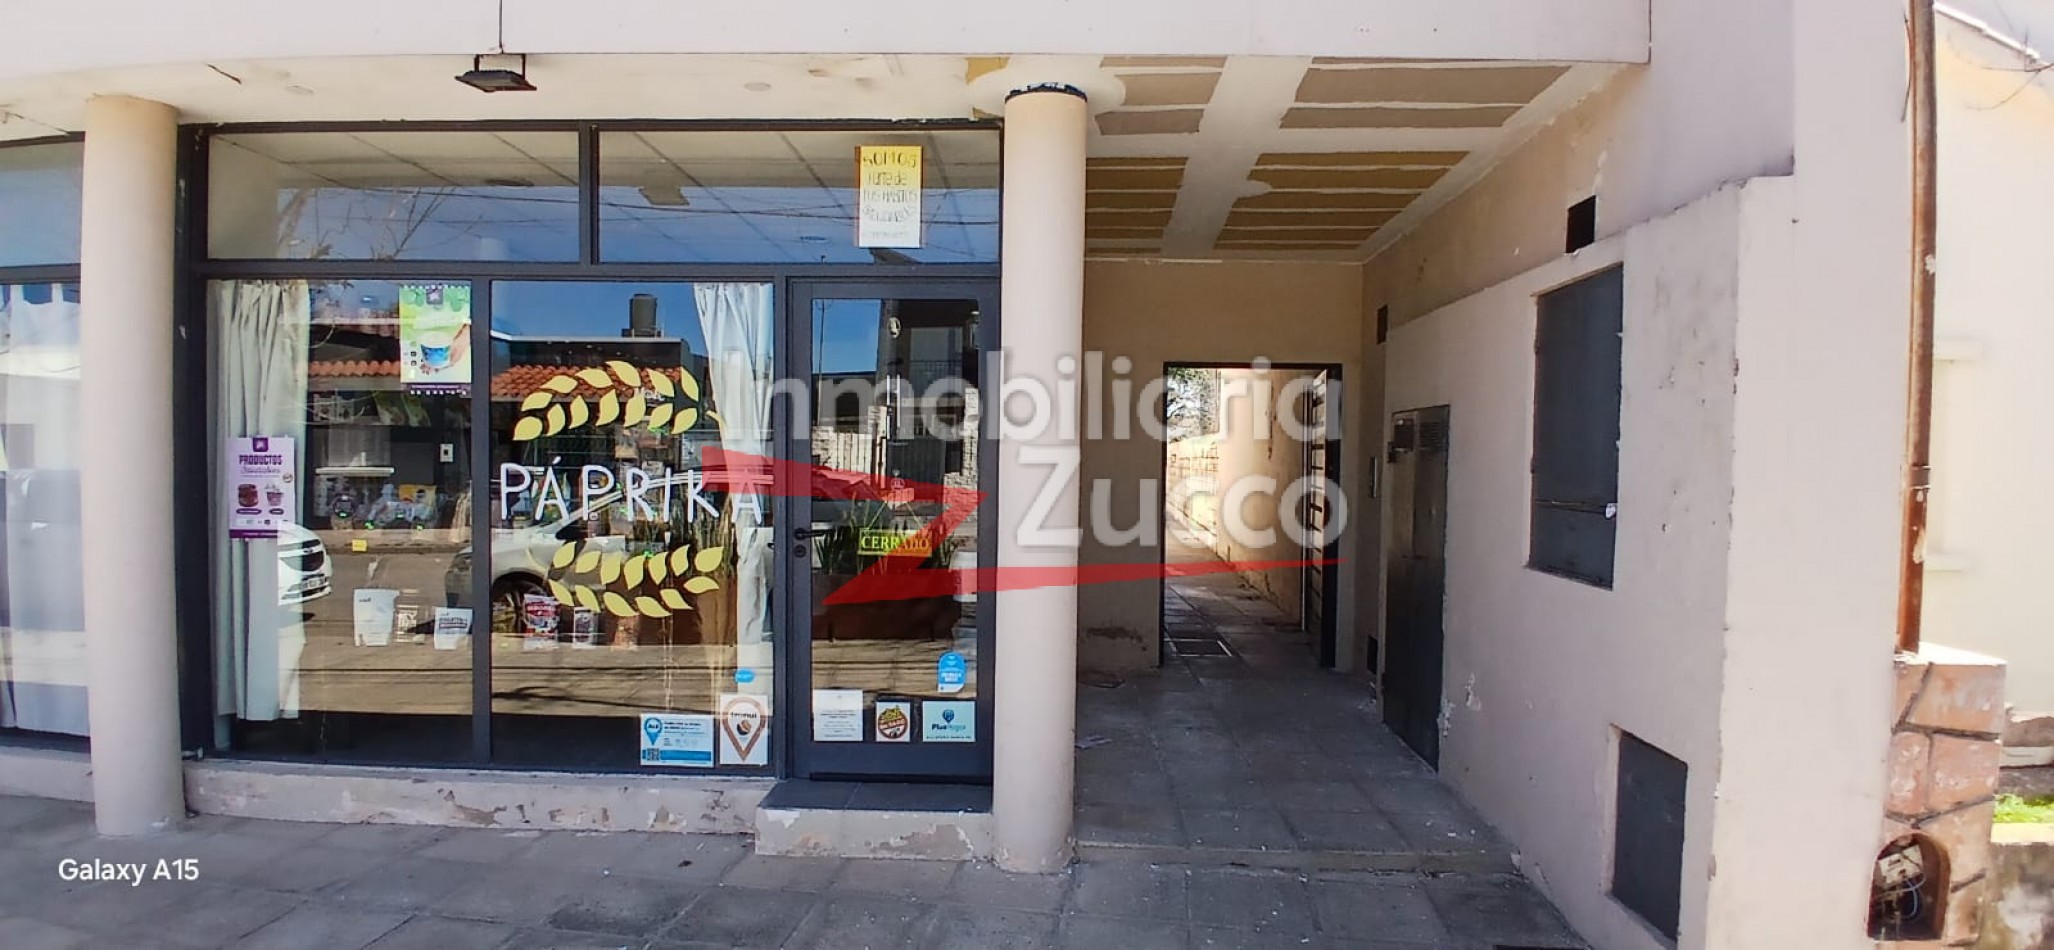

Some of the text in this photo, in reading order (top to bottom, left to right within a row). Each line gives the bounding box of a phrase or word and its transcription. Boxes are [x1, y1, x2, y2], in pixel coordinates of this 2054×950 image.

[238, 454, 283, 465] PRODUCTOS
[500, 456, 763, 525] PÁPRIKA
[861, 536, 929, 550] CERRADO
